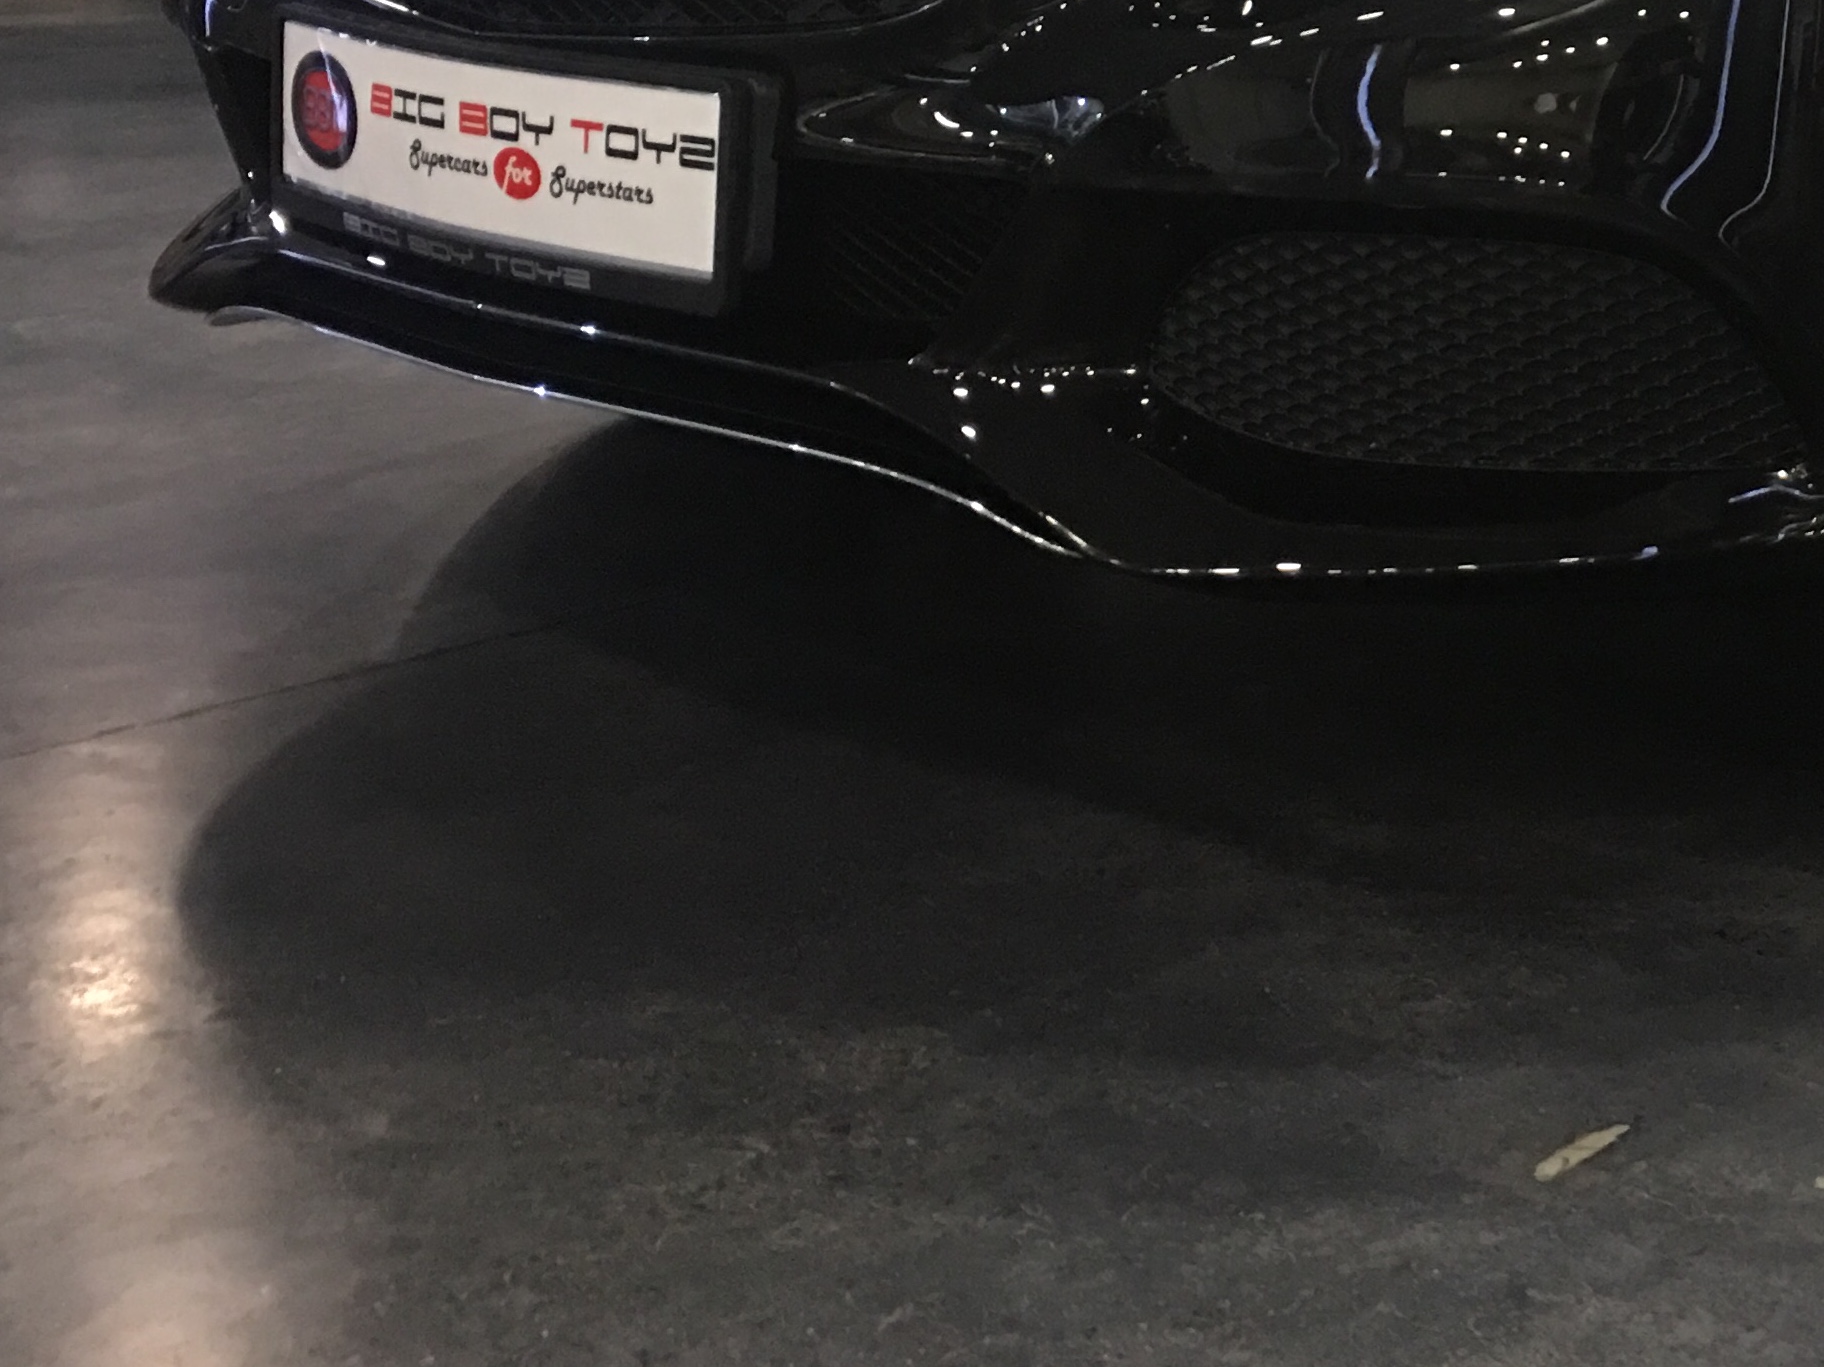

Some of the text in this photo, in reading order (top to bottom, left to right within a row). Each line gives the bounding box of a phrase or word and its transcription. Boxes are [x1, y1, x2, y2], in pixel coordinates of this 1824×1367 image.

[370, 83, 716, 172] BIG BOY TOYZ
[409, 138, 655, 206] Supercars for Superstars
[342, 210, 402, 248] BIG
[407, 233, 474, 266] BOY
